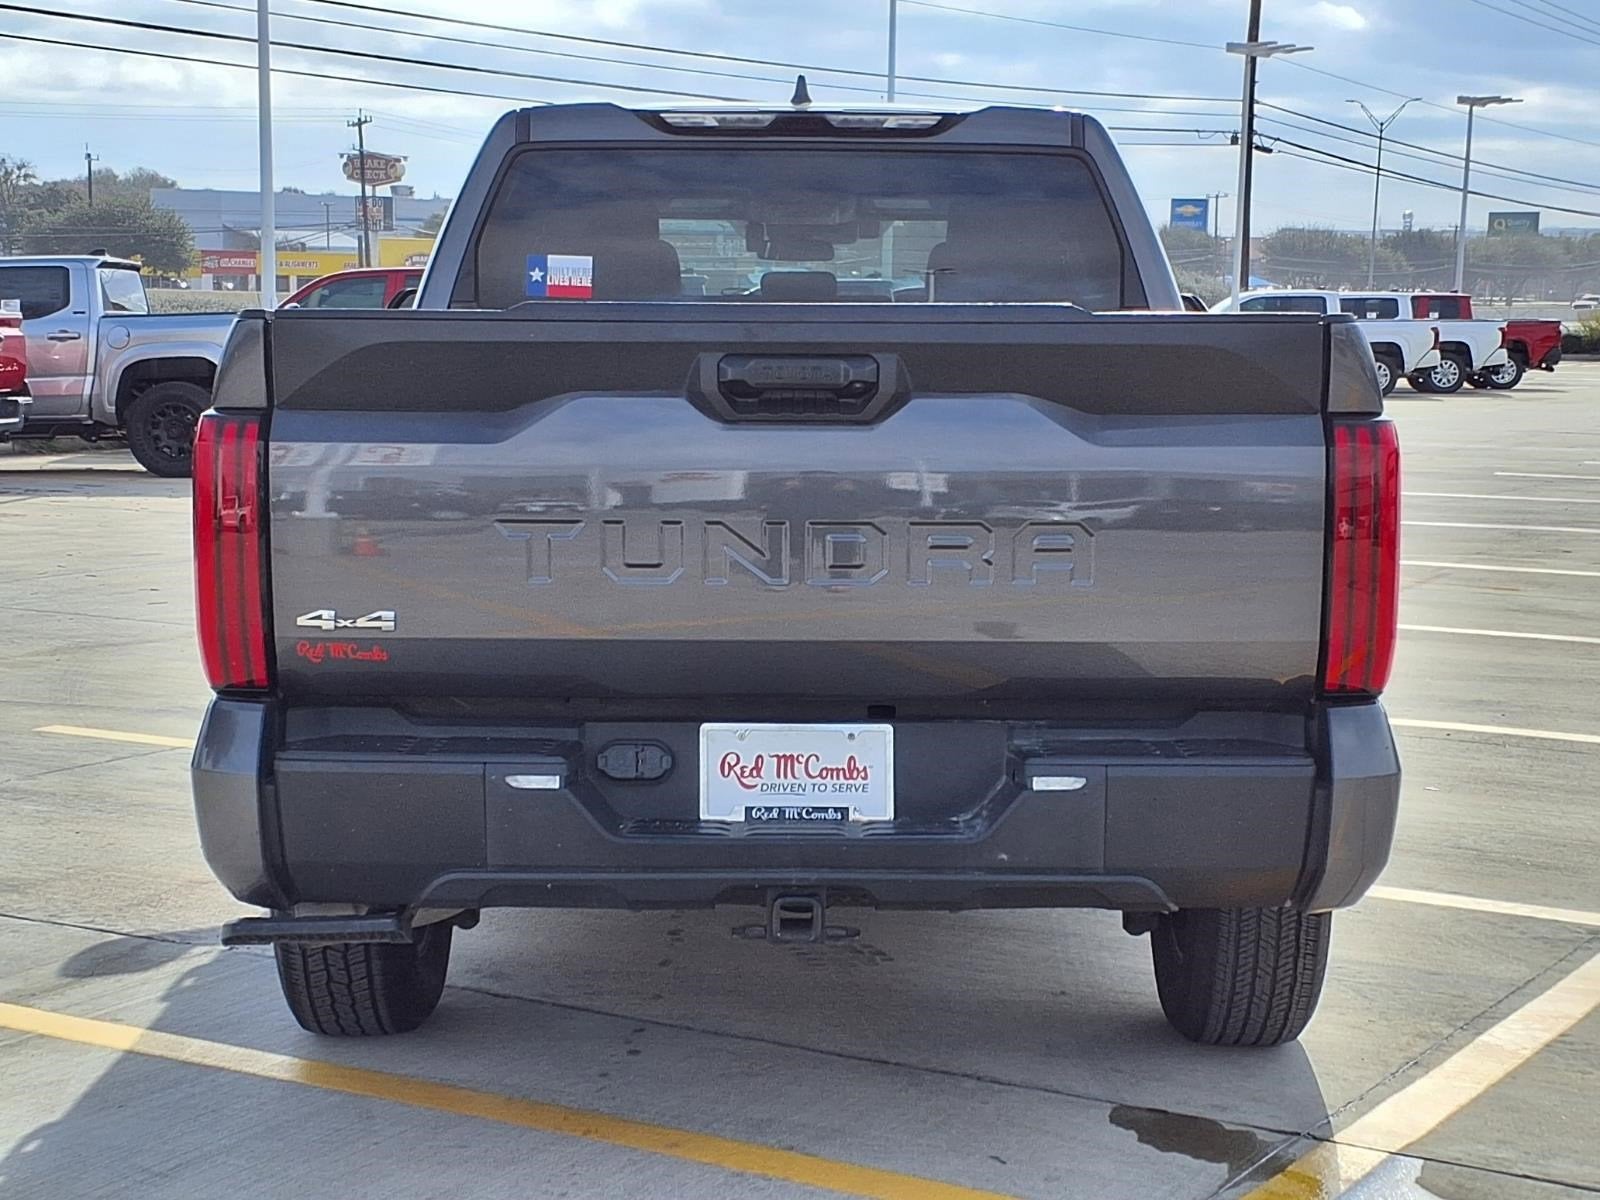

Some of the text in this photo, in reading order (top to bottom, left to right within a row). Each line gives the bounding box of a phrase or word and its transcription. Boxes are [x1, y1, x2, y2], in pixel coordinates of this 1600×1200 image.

[547, 275, 592, 286] LIVES HERE
[493, 519, 1096, 586] TUNDRA
[296, 609, 395, 631] 4x4
[296, 640, 325, 663] Red
[719, 751, 868, 790] Red McCombs
[760, 782, 869, 793] DRIVEN TO SERVE
[751, 806, 842, 820] Red McCombs
